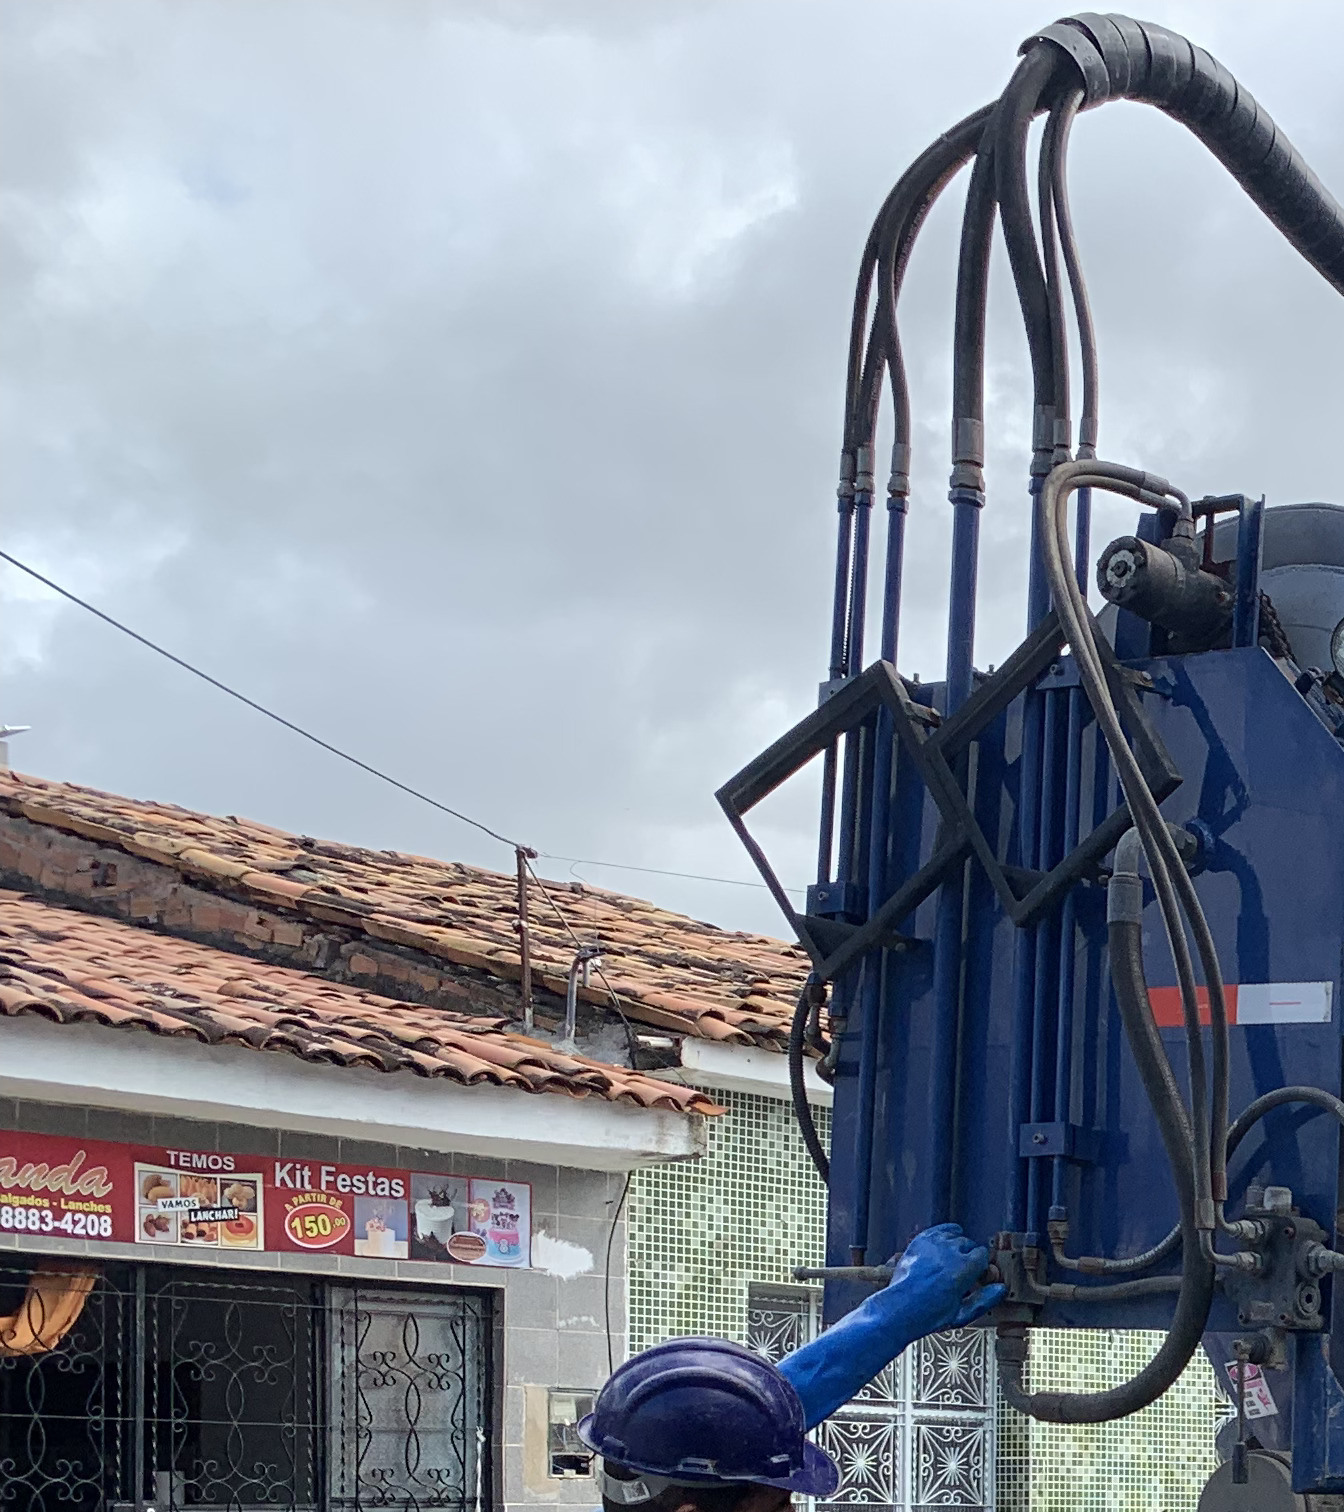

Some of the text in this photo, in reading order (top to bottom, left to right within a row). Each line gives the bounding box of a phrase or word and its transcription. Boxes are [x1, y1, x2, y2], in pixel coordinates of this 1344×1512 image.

[167, 1150, 235, 1170] TEMOS
[274, 1161, 405, 1198] Kit Festas
[60, 1198, 112, 1213] Lanches
[160, 1199, 198, 1209] VAMOS
[292, 1193, 327, 1206] PARTIR
[329, 1197, 343, 1209] DE
[0, 1206, 112, 1237] 8883-4208
[191, 1208, 239, 1222] LANCHAR!
